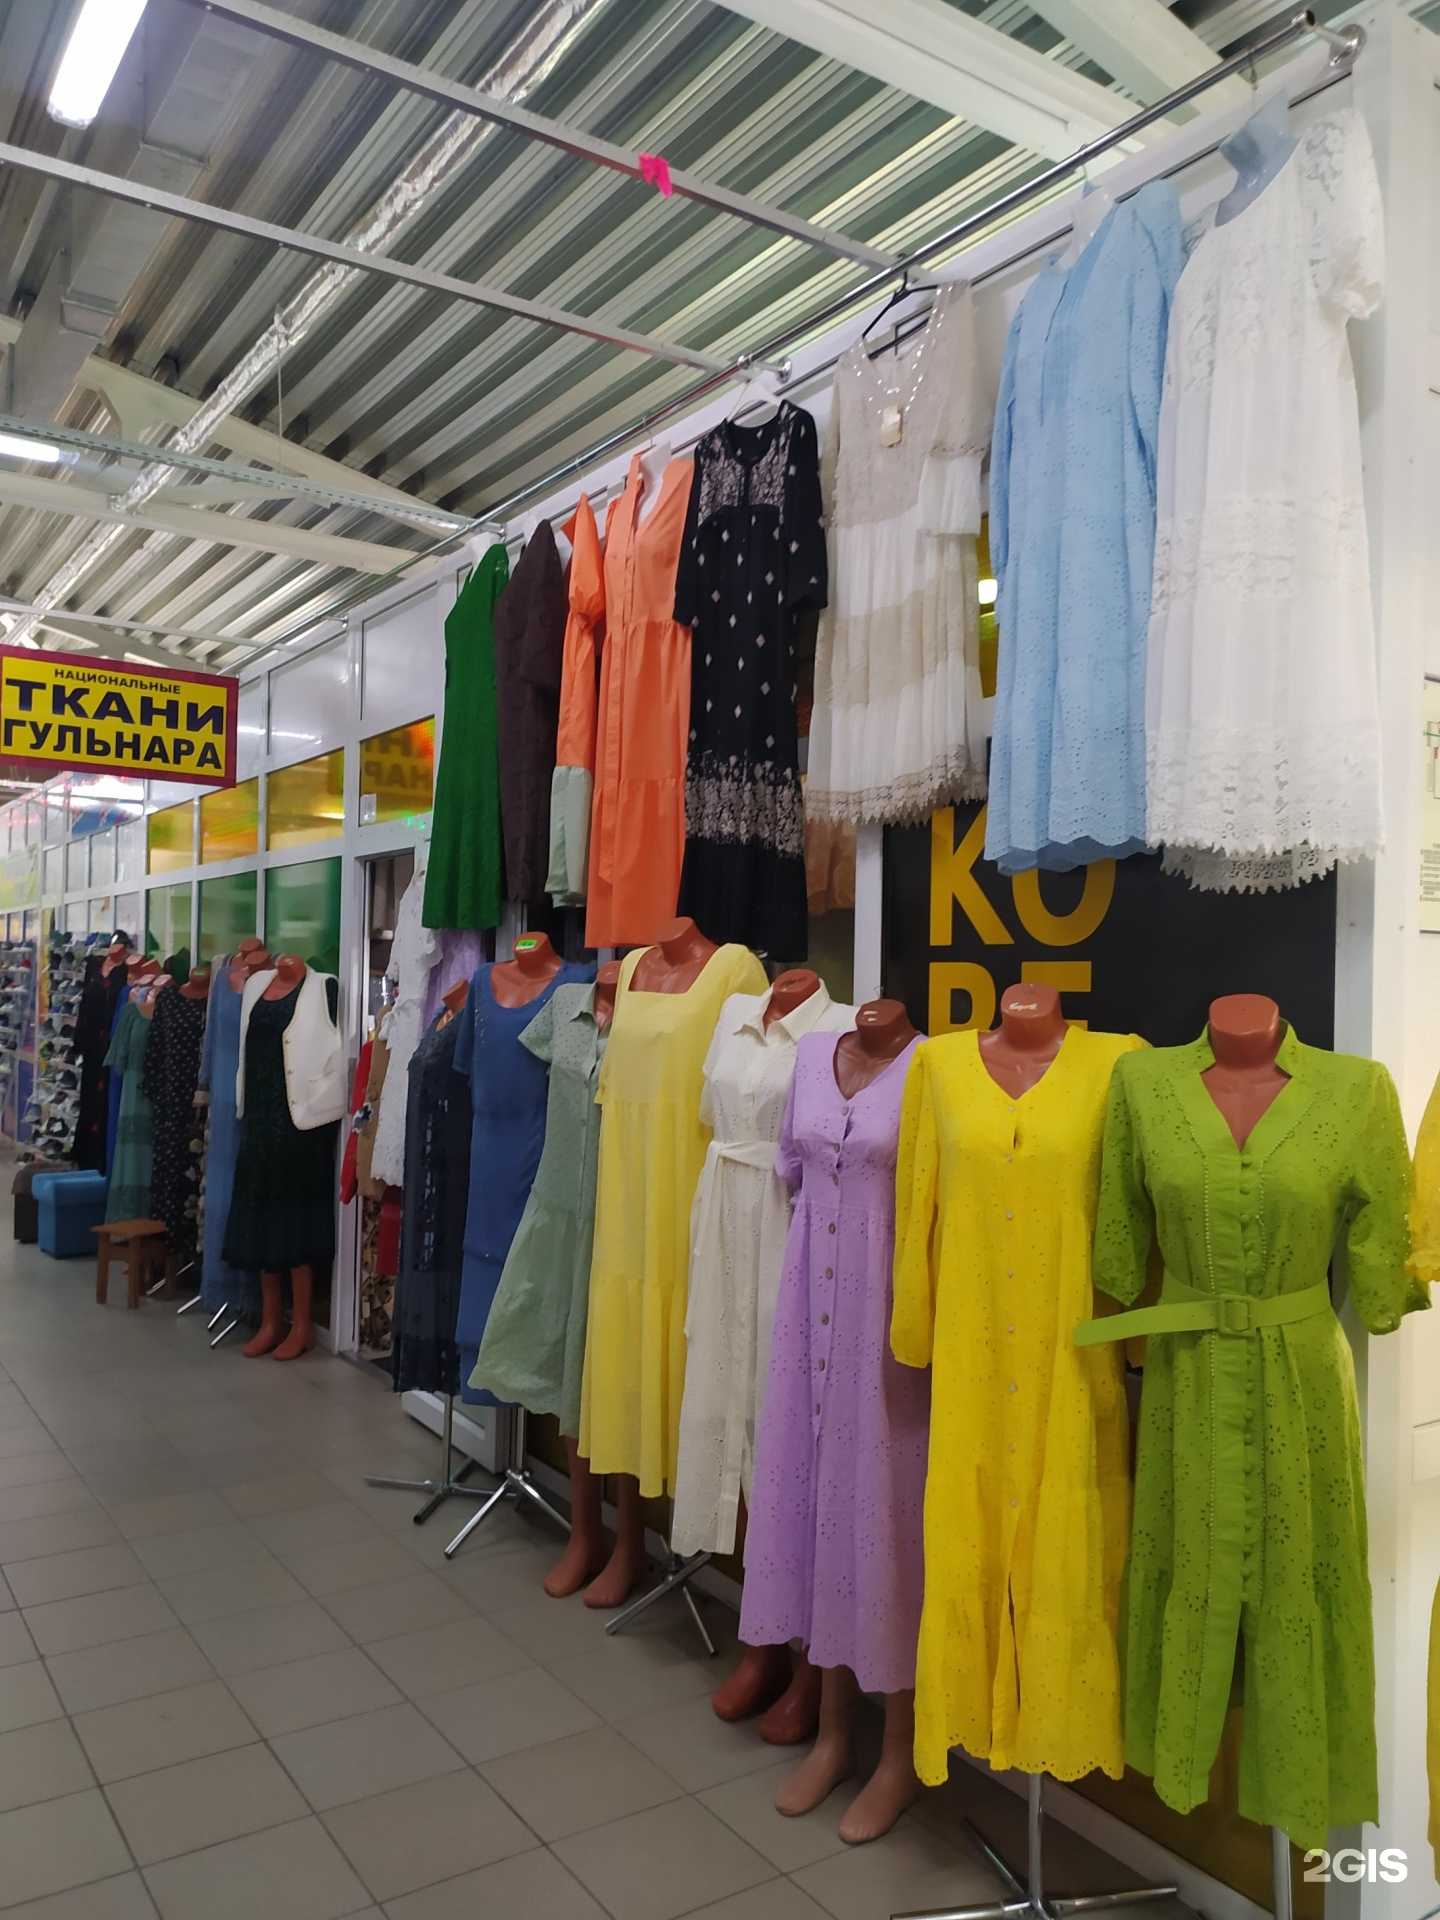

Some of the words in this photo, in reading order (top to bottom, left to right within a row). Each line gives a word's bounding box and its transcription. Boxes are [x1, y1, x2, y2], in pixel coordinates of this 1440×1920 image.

[5, 678, 225, 735] ТКАНИ
[54, 668, 182, 695] НАЦИОНАЛЬНЫЕ
[3, 718, 223, 770] ГУЛЬНАРА
